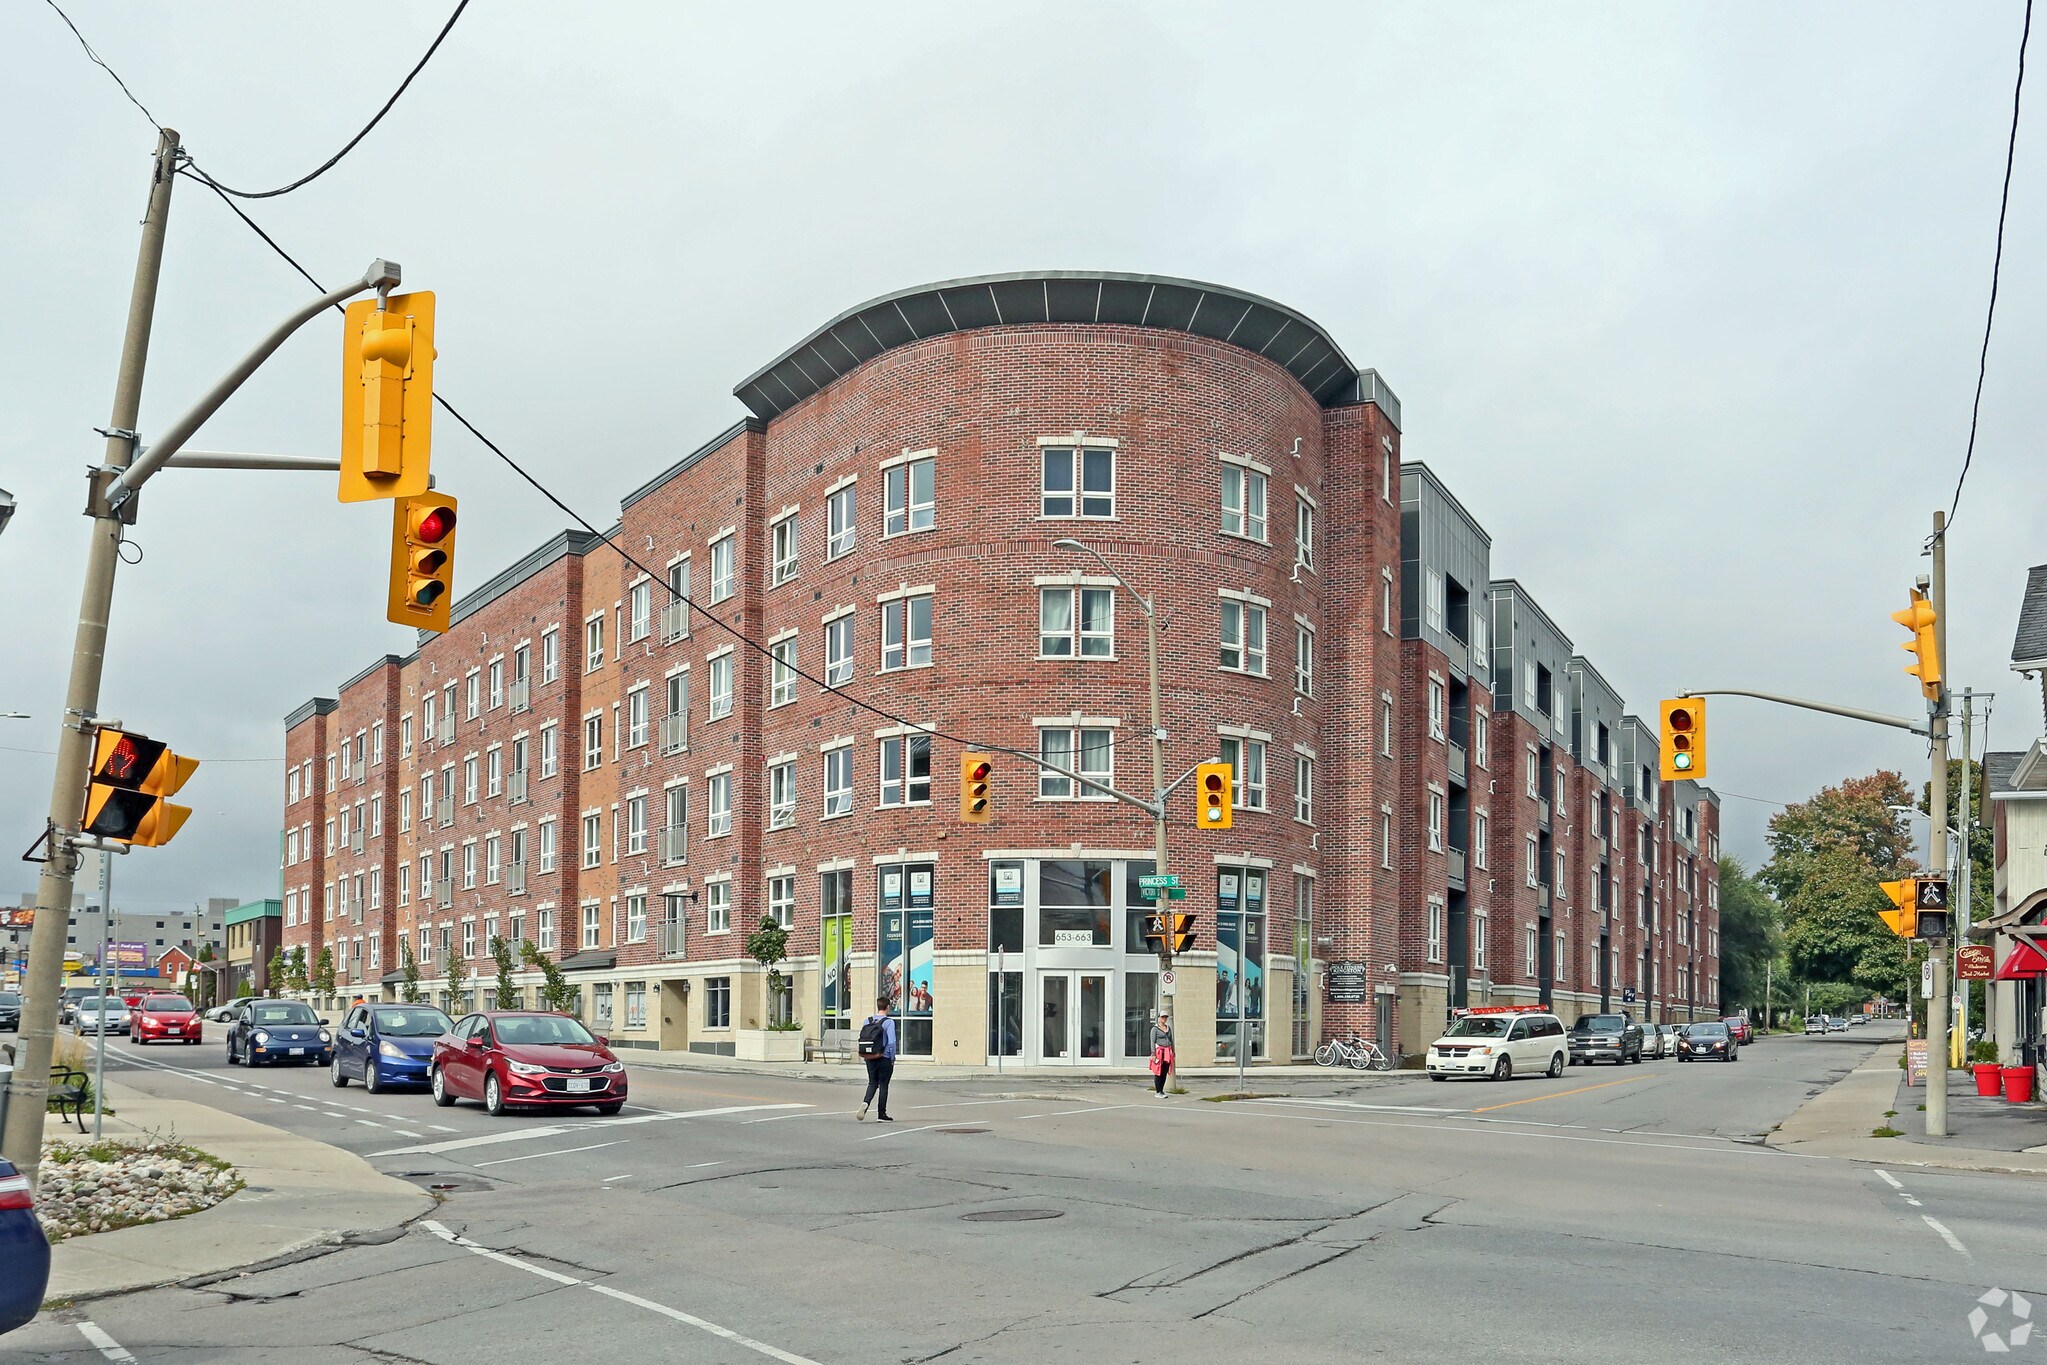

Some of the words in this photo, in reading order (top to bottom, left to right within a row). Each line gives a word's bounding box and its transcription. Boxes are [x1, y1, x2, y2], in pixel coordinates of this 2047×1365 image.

[1138, 876, 1168, 886] PRINCESS
[1172, 876, 1180, 884] ST
[1056, 933, 1092, 942] 653-663
